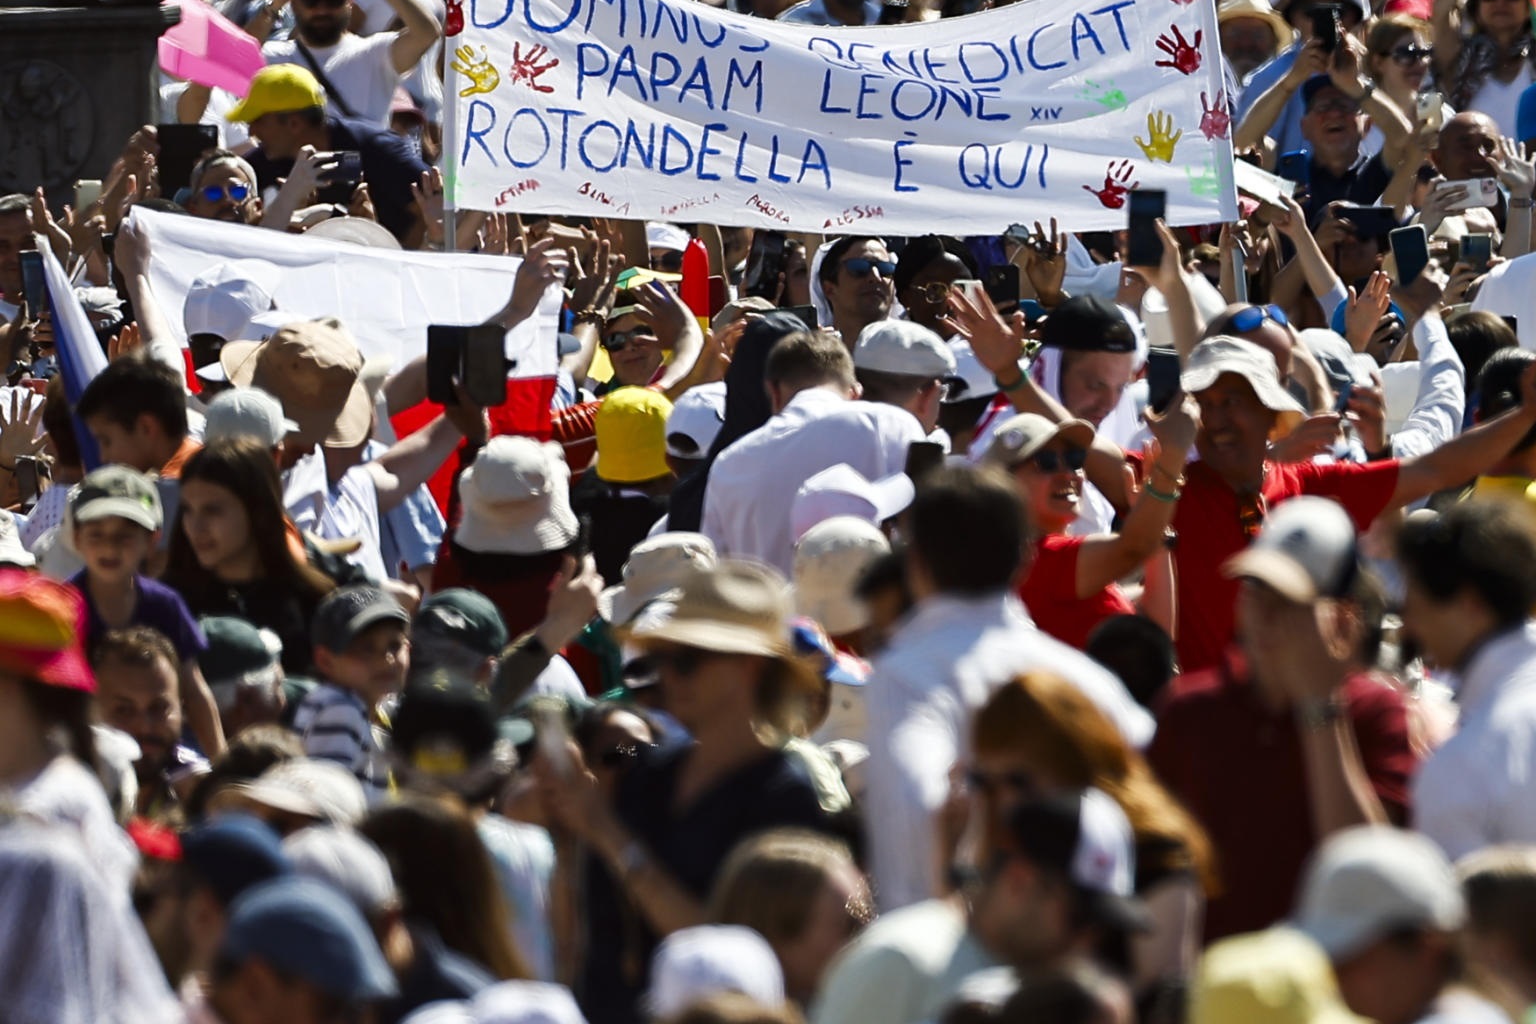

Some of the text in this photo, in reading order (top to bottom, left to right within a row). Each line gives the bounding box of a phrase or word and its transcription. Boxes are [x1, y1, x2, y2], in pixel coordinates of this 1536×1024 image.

[576, 42, 1063, 122] PAPAM LEONE XIV
[461, 99, 832, 191] ROTONDELLA
[958, 142, 1049, 190] QUI
